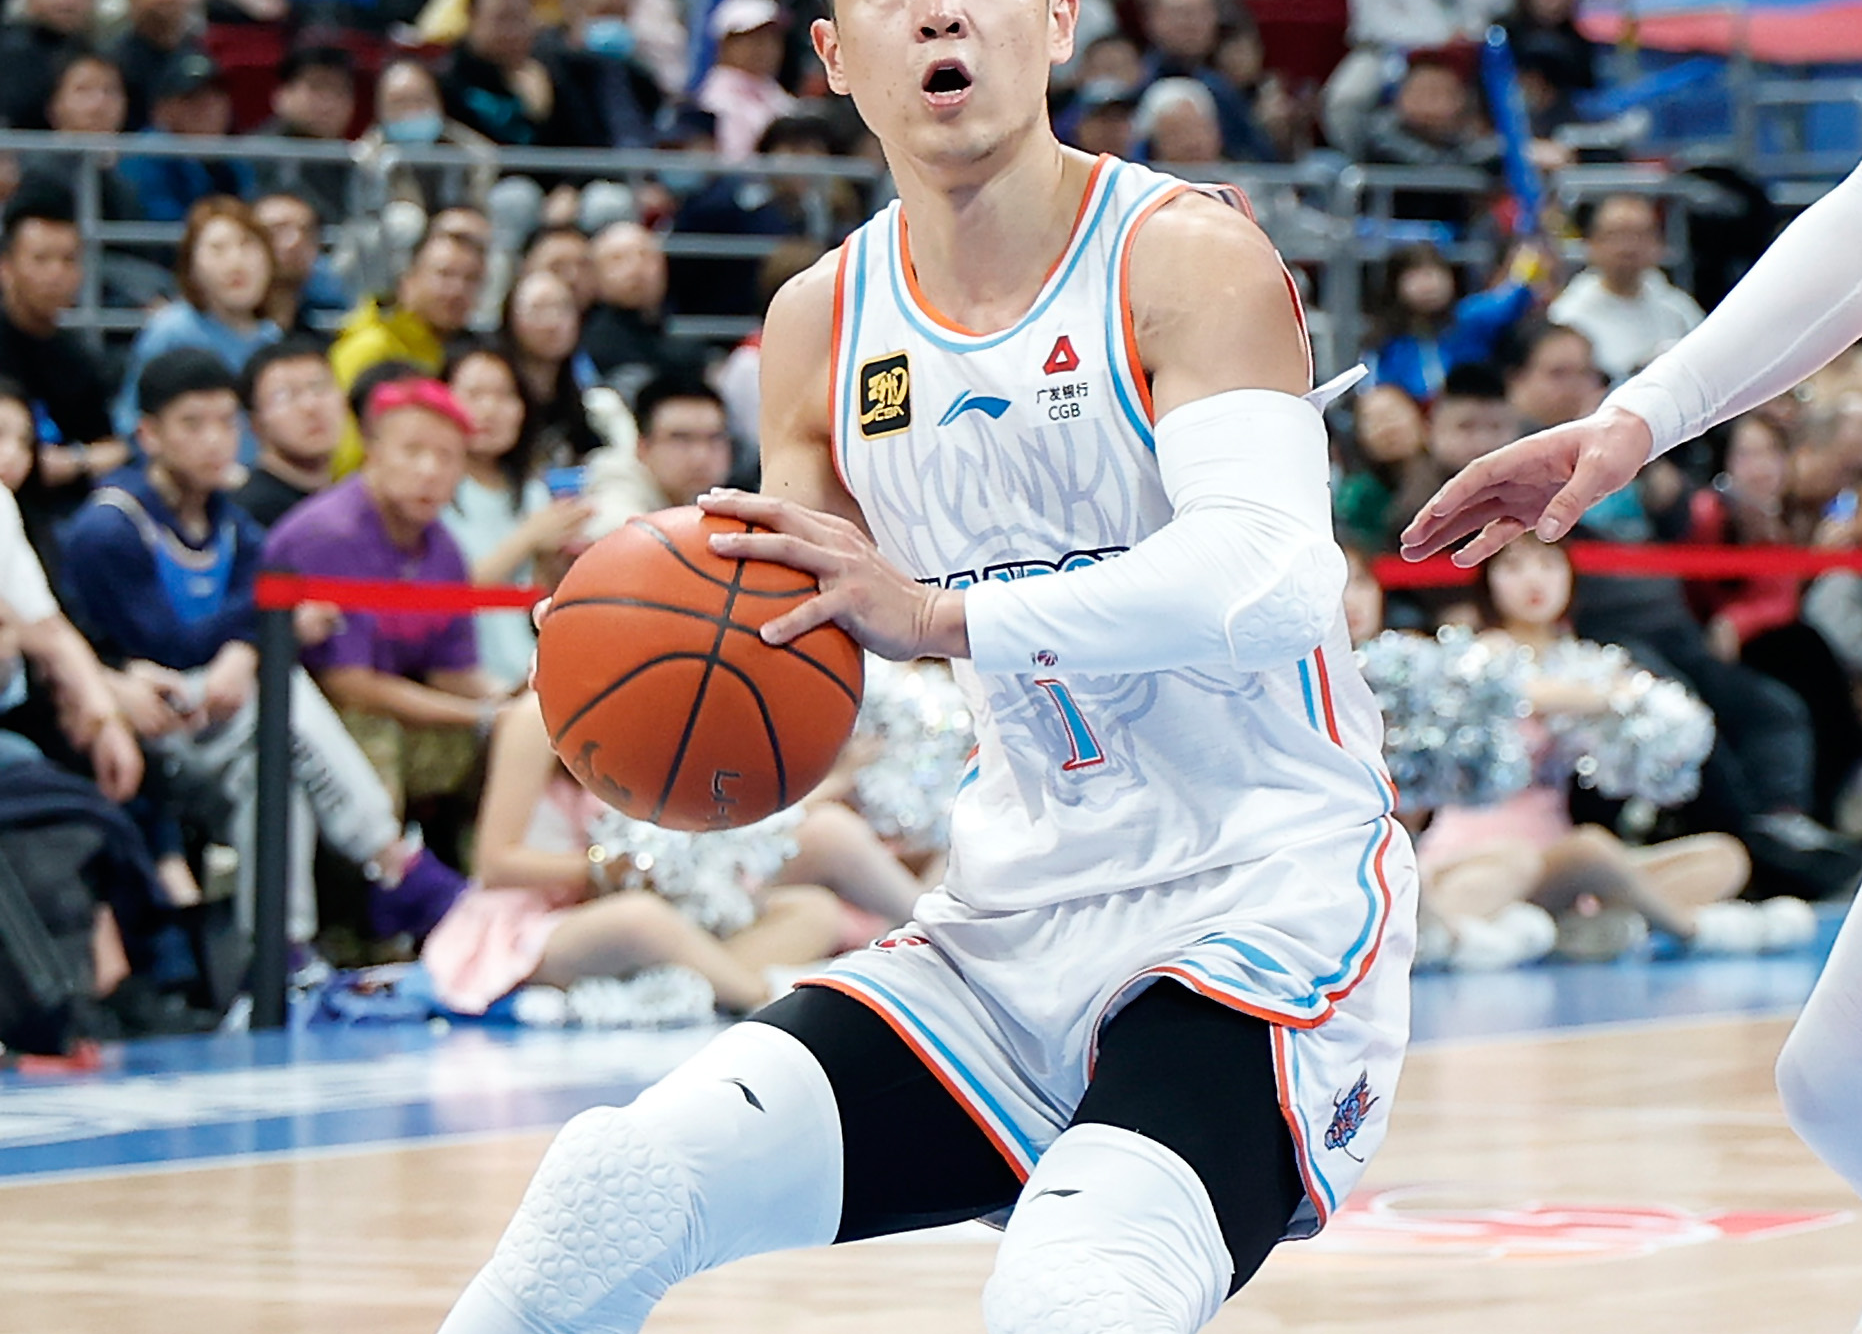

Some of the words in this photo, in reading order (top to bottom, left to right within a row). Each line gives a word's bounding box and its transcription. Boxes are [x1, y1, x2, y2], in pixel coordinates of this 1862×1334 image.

[1036, 382, 1088, 404] 广发银行
[1048, 402, 1081, 421] CGB
[1034, 678, 1105, 772] 1
